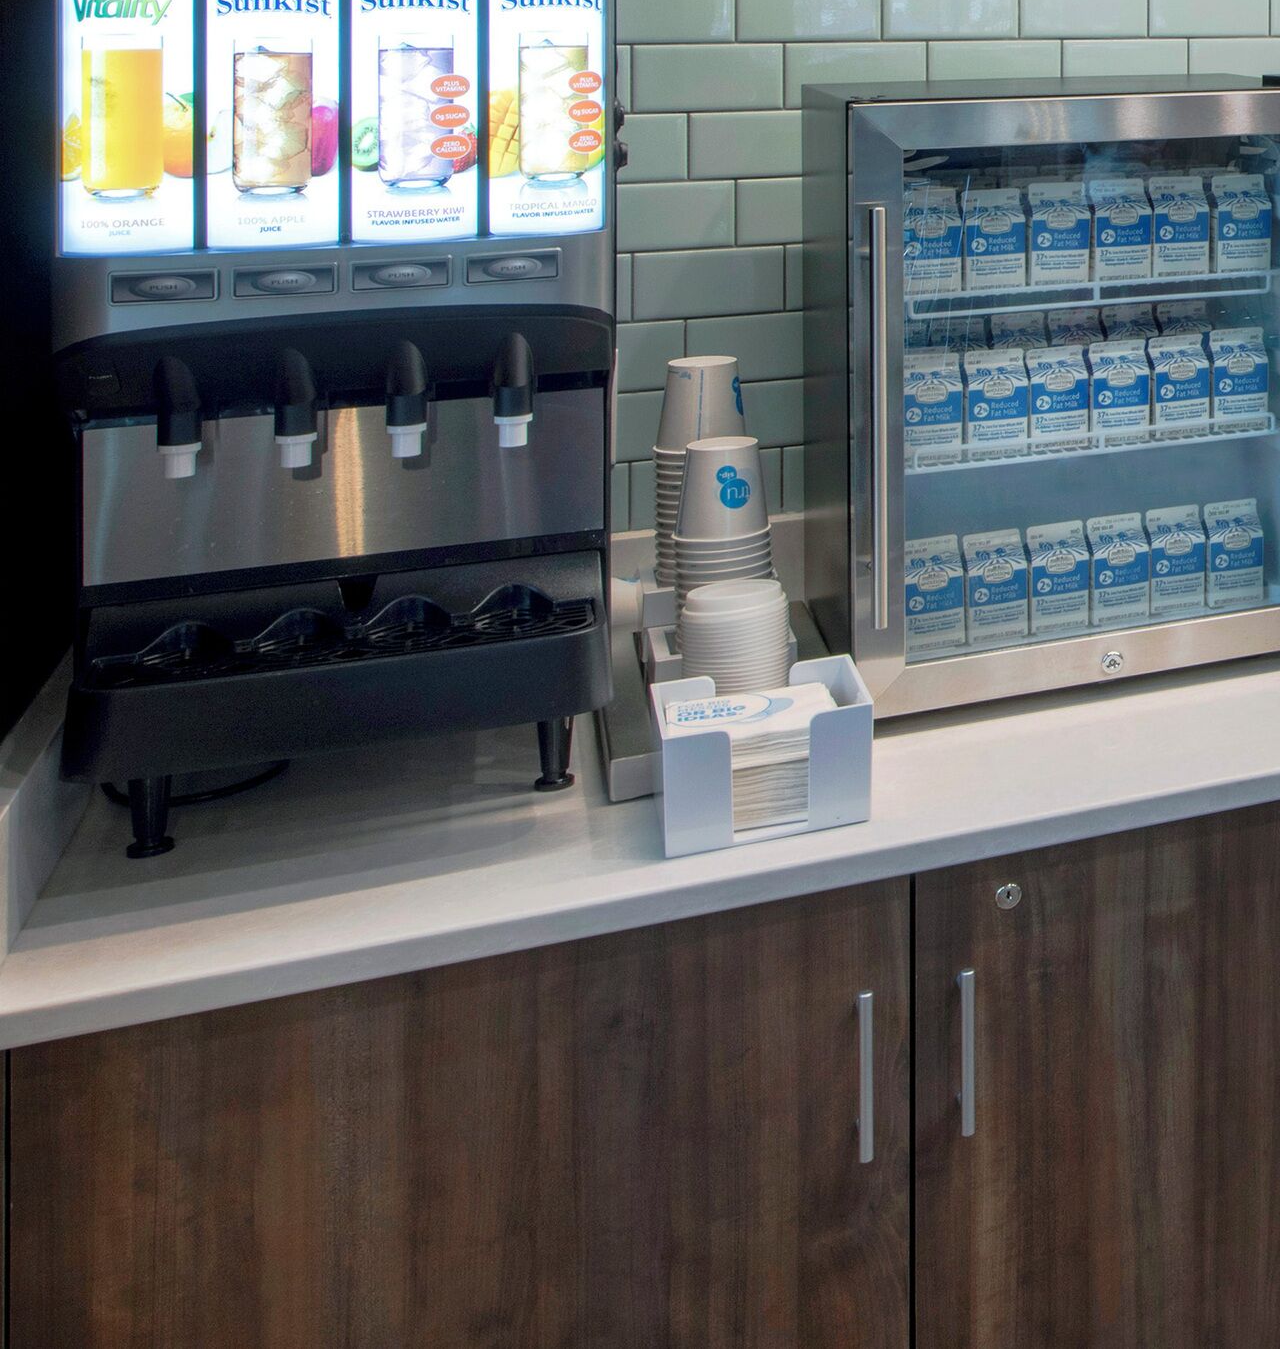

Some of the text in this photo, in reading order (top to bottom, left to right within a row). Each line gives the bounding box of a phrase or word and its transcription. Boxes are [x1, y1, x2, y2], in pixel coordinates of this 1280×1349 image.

[436, 85, 467, 93] VITAMINS
[573, 81, 599, 89] VITAMINS
[582, 107, 599, 115] SUGAR
[445, 112, 467, 120] SUGAR
[436, 145, 467, 153] CALORIES
[510, 201, 559, 212] TROPICAL
[367, 206, 465, 219] STRAWBERRY KIWI
[542, 209, 573, 218] INFUSED
[574, 207, 595, 216] WATER
[81, 217, 165, 229] 100% ORANGE
[238, 214, 305, 226] 100% APPLE
[371, 215, 461, 227] FLAVOR INFUSED WATER
[108, 229, 131, 237] JUICE
[500, 264, 526, 272] PUSH
[387, 270, 415, 279] PUSH
[270, 277, 299, 286] PUSH
[148, 283, 178, 292] PUSH
